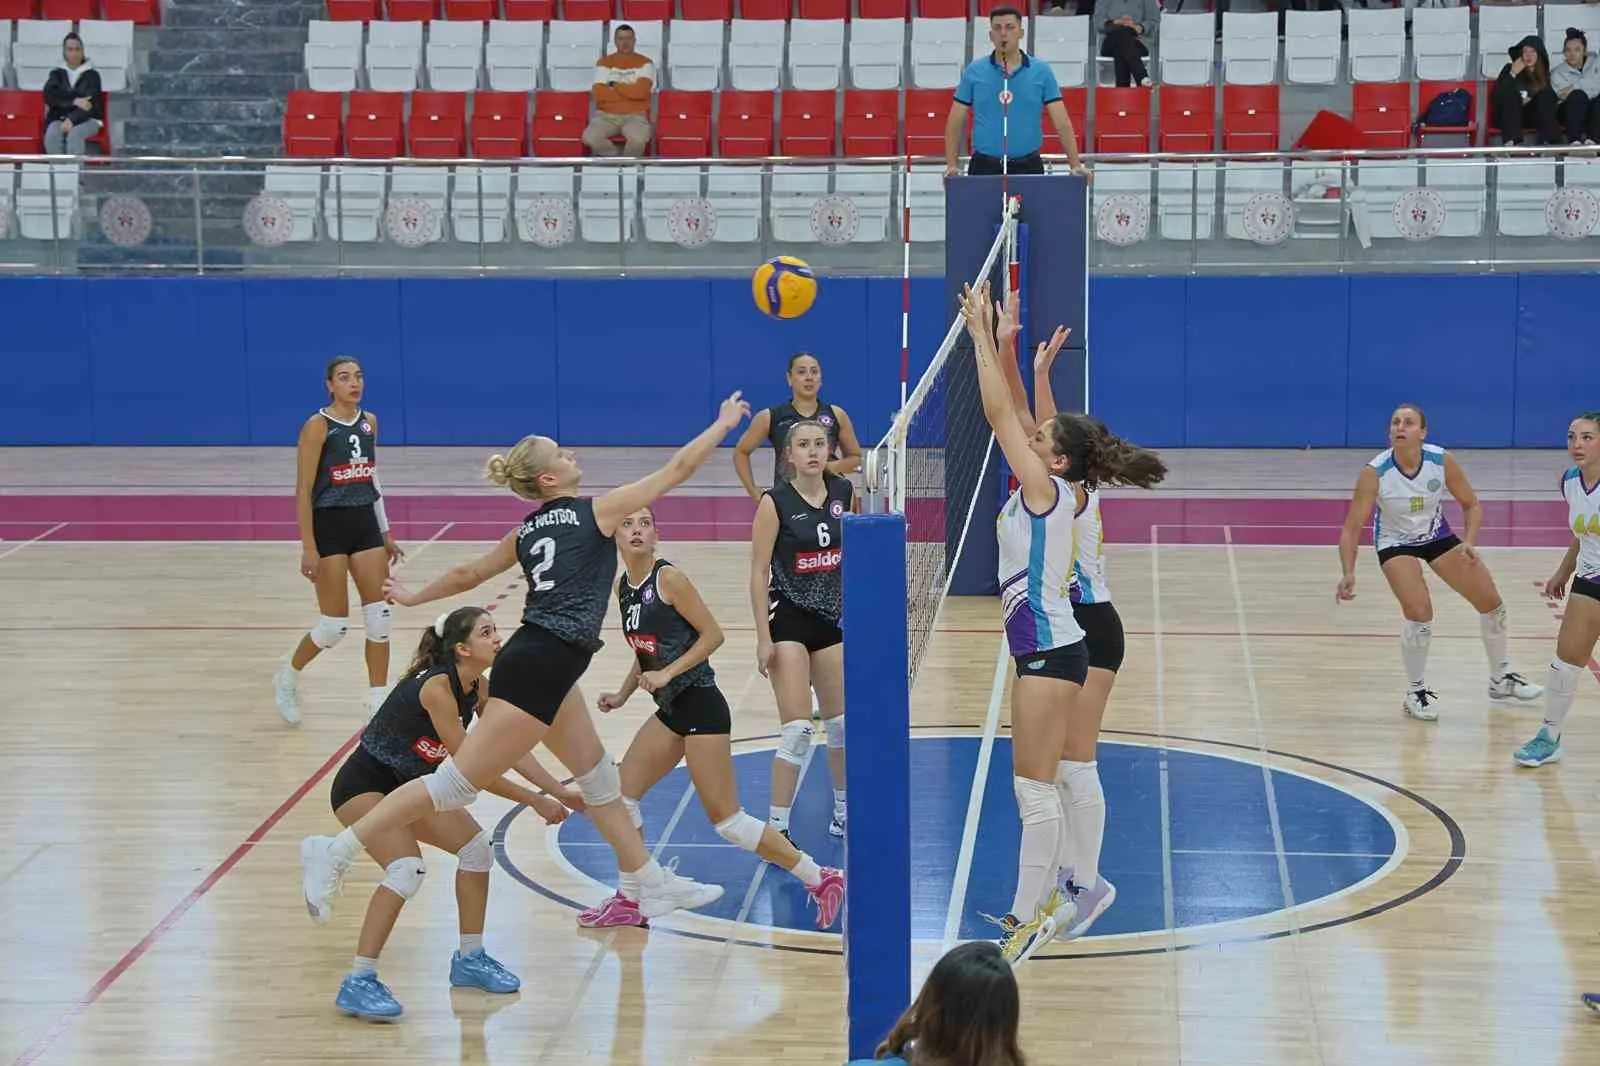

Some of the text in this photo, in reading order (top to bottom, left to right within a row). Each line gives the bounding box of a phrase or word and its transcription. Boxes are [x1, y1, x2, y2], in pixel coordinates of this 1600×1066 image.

[349, 434, 362, 458] 3
[816, 522, 832, 548] 6
[529, 536, 556, 592] 2
[798, 550, 842, 570] saldo
